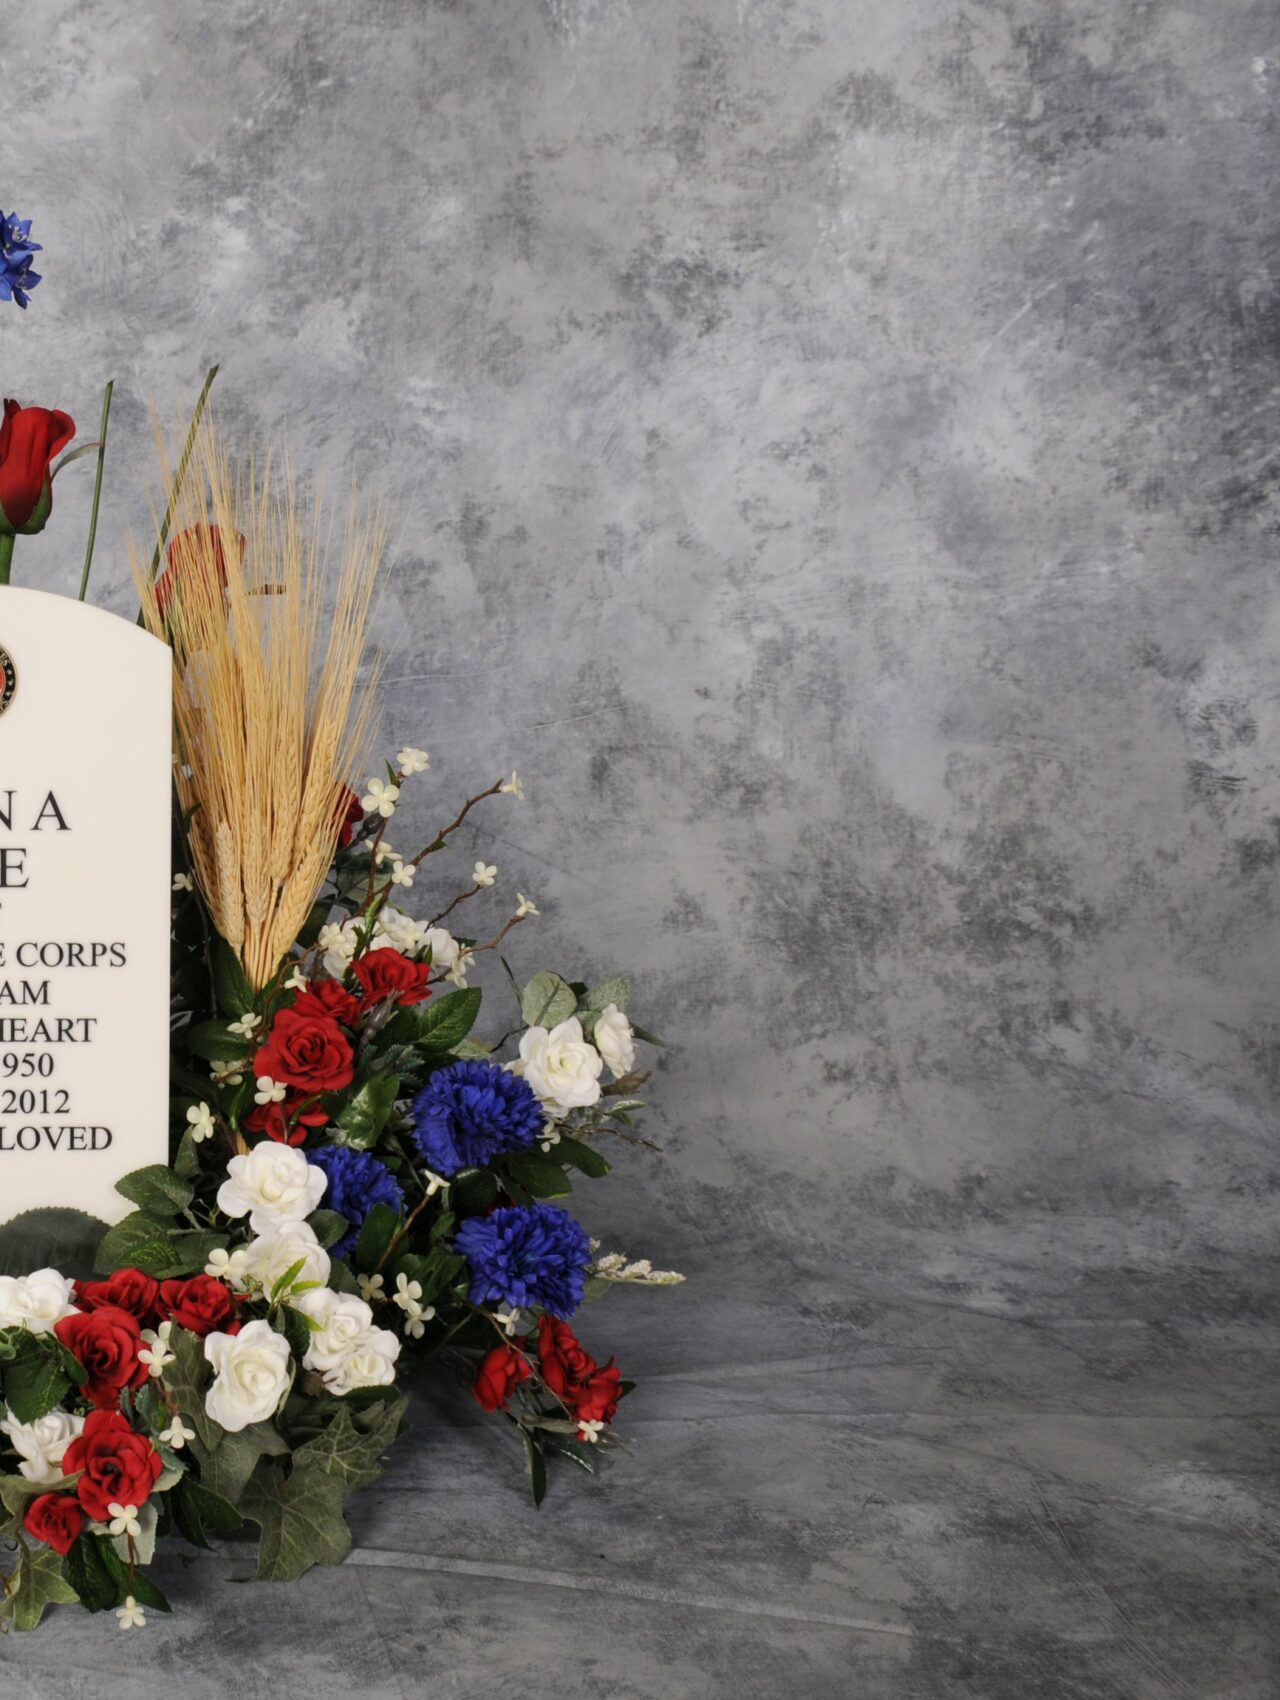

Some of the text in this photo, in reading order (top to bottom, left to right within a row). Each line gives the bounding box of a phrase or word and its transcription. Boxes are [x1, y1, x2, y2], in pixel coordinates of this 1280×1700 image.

[31, 790, 71, 831] A
[16, 942, 126, 968] CORPS
[1, 1090, 70, 1114] 2012
